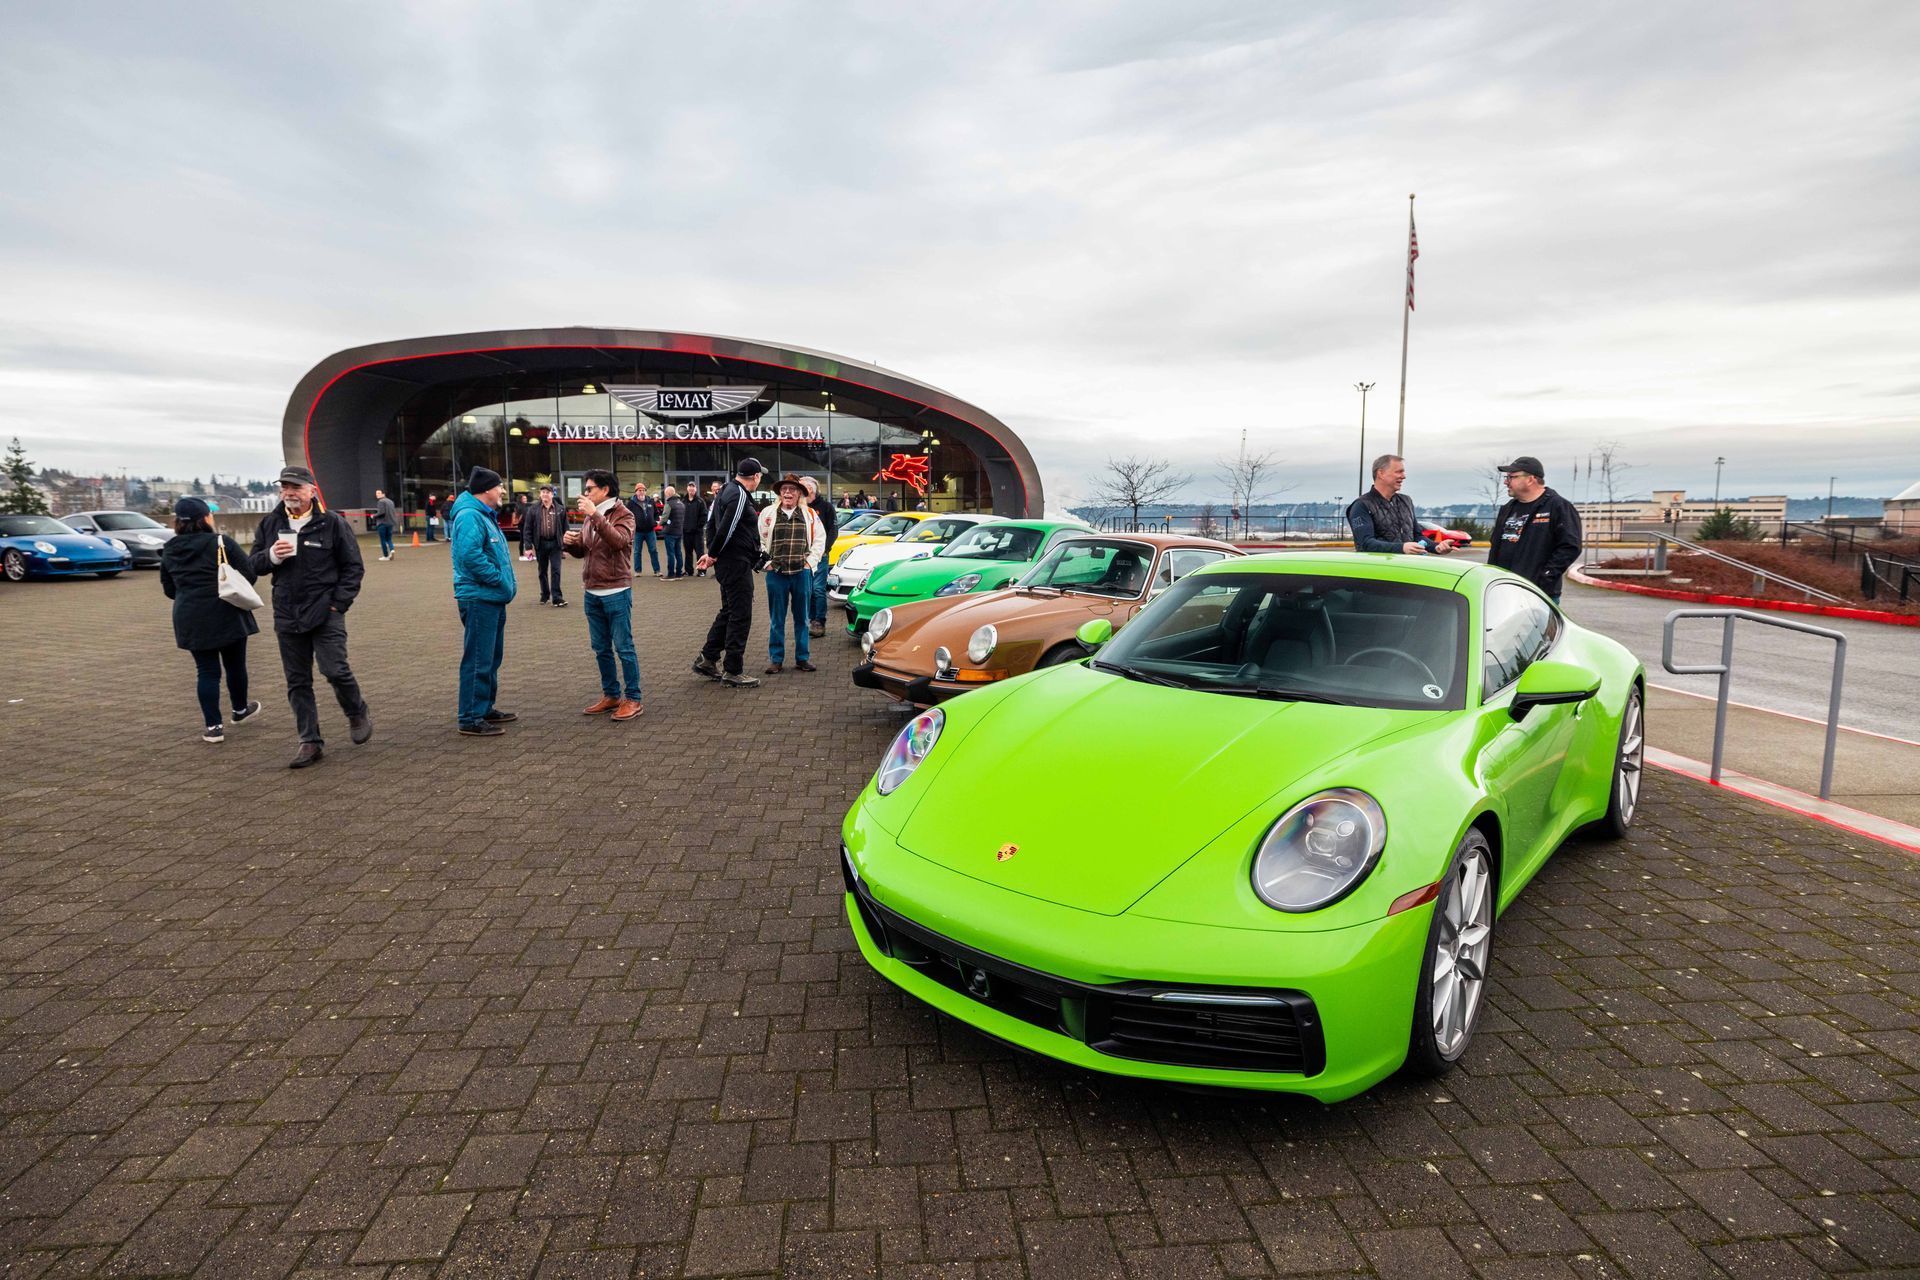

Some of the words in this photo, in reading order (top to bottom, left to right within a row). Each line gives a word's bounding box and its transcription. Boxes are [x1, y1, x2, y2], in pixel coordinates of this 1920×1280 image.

[658, 393, 711, 409] LeMAY
[547, 423, 665, 440] AMERICA'S
[674, 423, 720, 440] CAR
[727, 423, 823, 440] MUSEUM
